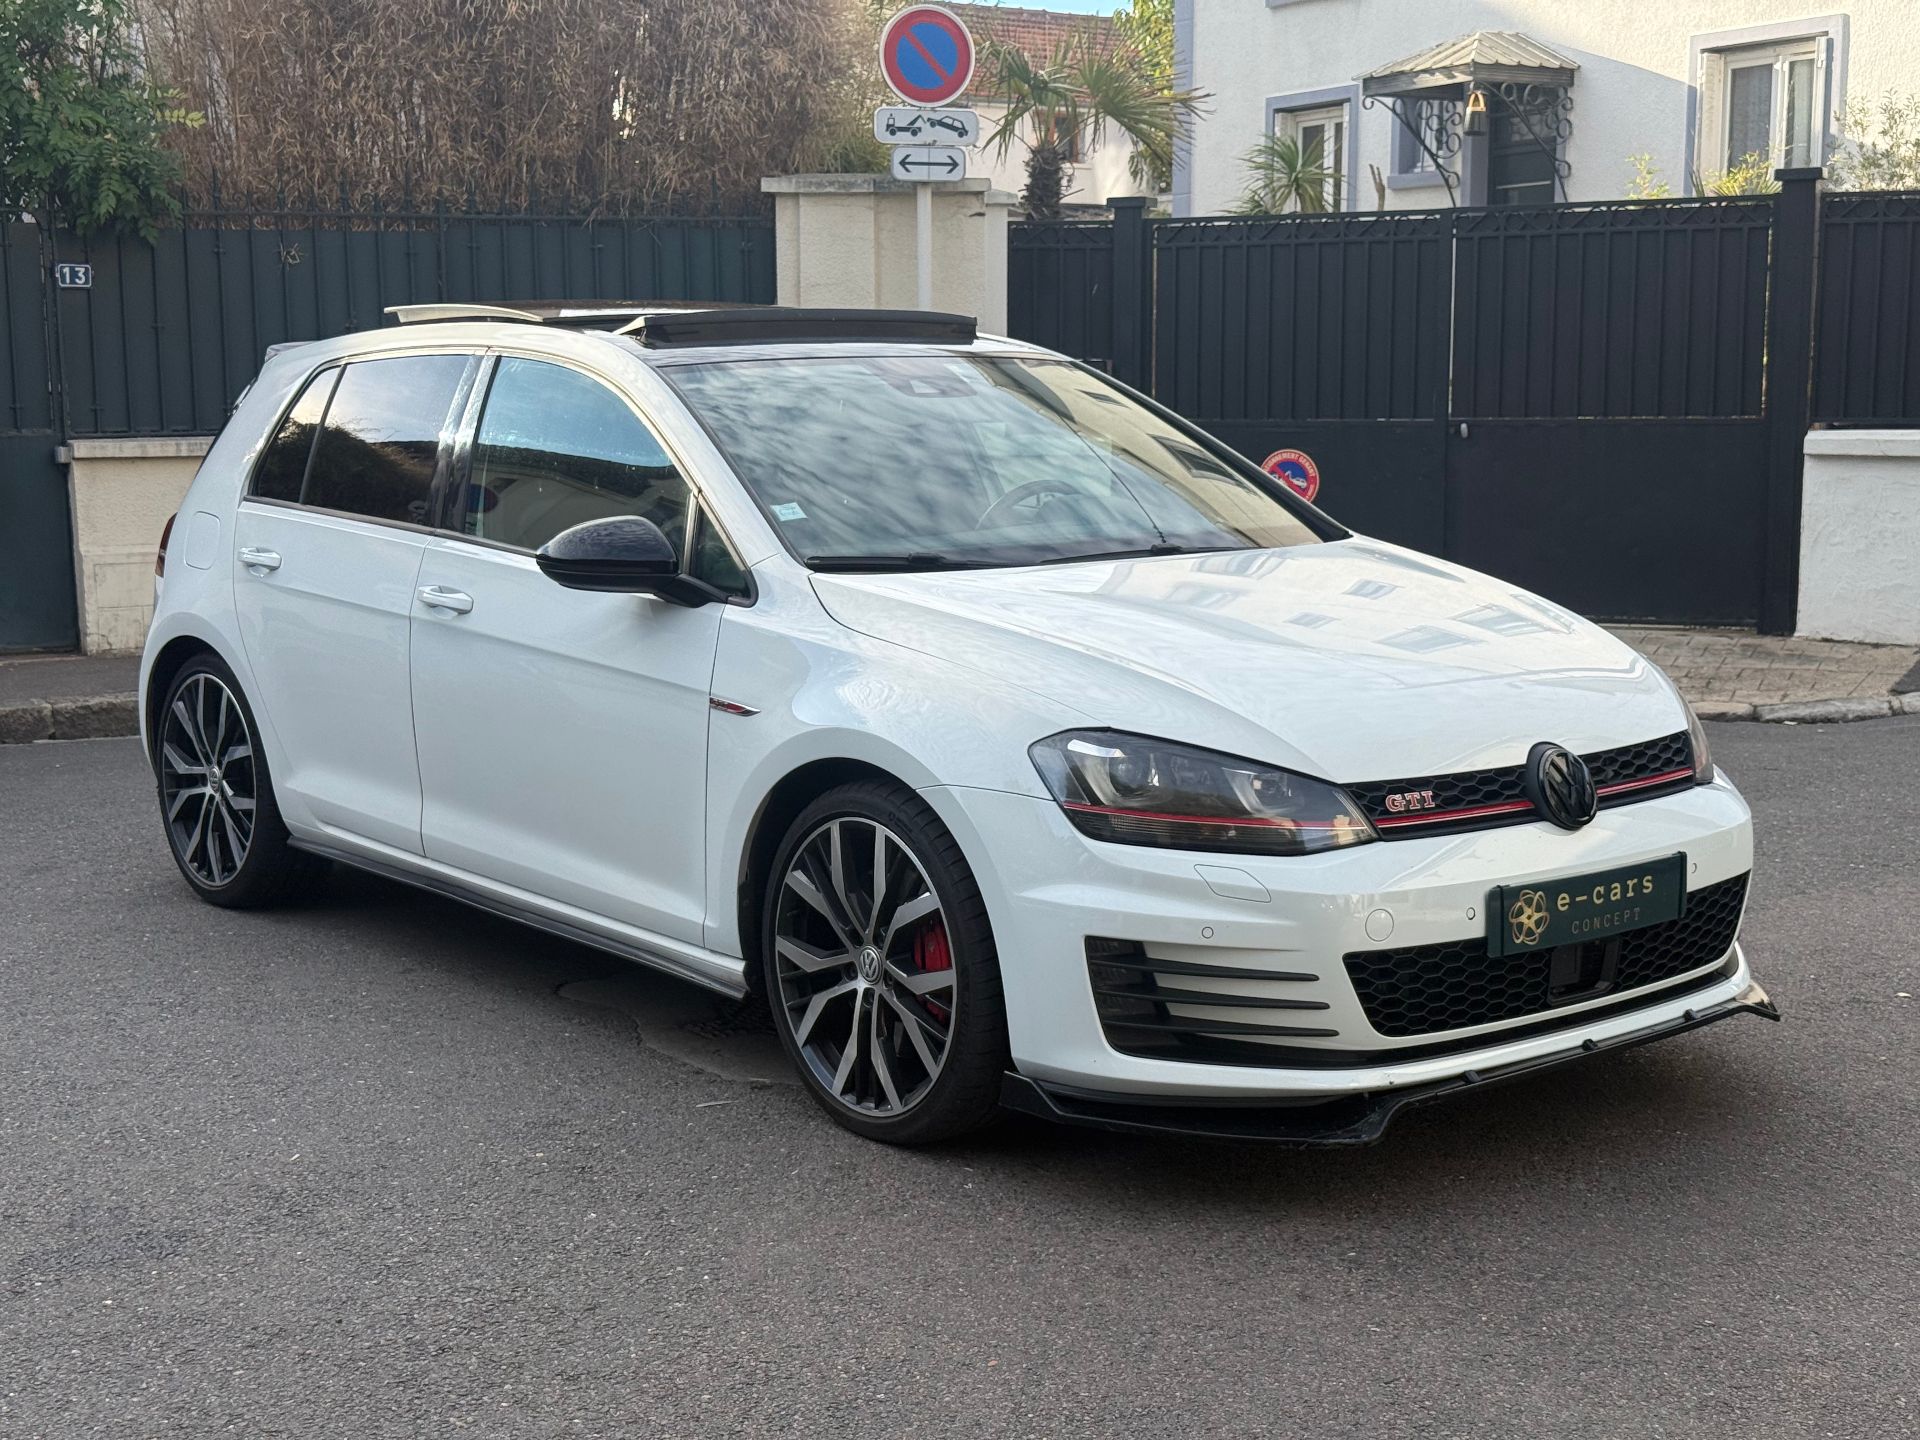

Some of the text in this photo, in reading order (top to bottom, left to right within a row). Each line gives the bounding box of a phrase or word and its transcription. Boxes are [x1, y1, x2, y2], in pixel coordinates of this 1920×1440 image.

[63, 267, 85, 284] 13
[1386, 791, 1435, 811] GTI
[1556, 875, 1653, 911] e-cars
[1571, 907, 1640, 934] CONCEPT
